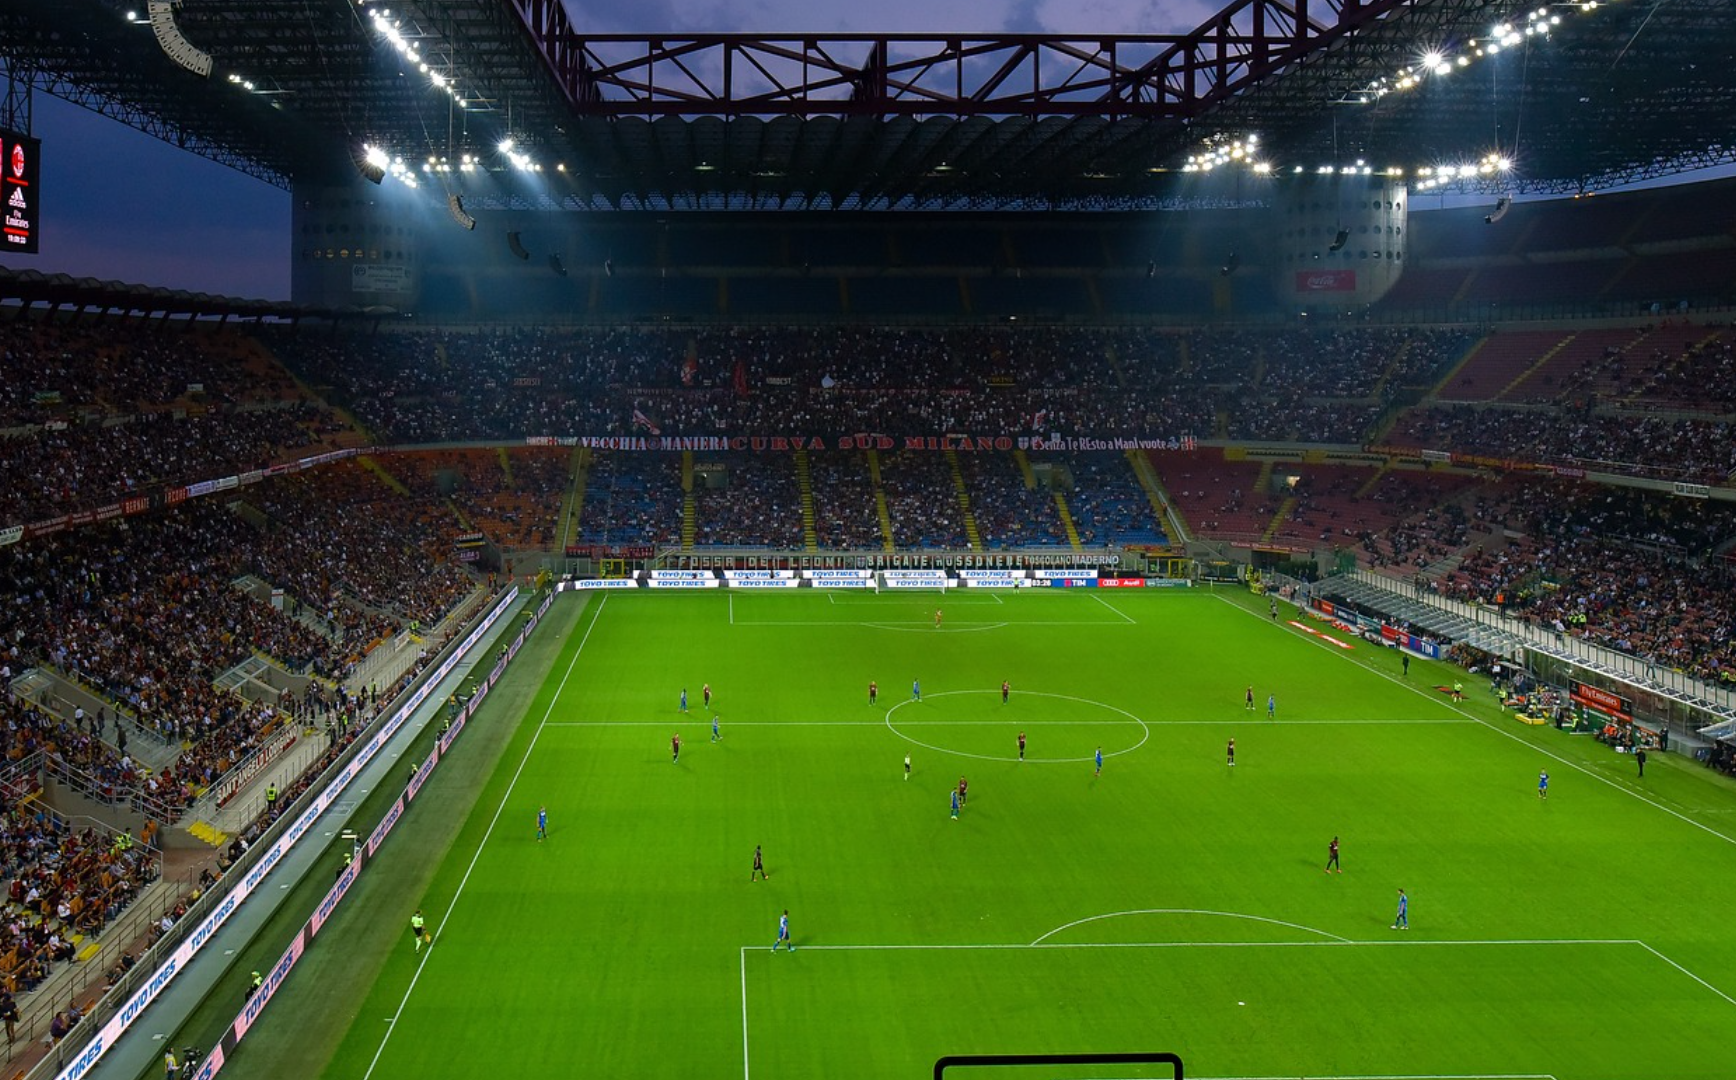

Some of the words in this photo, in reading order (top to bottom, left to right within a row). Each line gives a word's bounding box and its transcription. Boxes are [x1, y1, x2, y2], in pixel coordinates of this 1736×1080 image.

[580, 436, 647, 450] VECCHIA
[660, 436, 729, 450] MANIERA
[732, 436, 825, 451] CURVA
[838, 436, 895, 451] SUD
[904, 436, 1013, 451] MILANO
[678, 556, 735, 568] FOSSA
[748, 556, 776, 568] DEI
[789, 556, 841, 568] LEONI
[868, 555, 928, 567] BRIGATE
[1420, 640, 1434, 656] TIM
[1581, 685, 1592, 698] Fly
[1591, 689, 1618, 707] Emirates
[246, 862, 265, 892] TOYO
[264, 844, 281, 871] TIRES
[191, 918, 214, 951] TOYO
[213, 894, 235, 927] TIRES
[119, 989, 149, 1028] TOYO
[147, 961, 176, 998] TIRES
[244, 983, 270, 1026] TOYO
[269, 949, 294, 992] TIRES
[66, 1036, 103, 1080] TIRES
